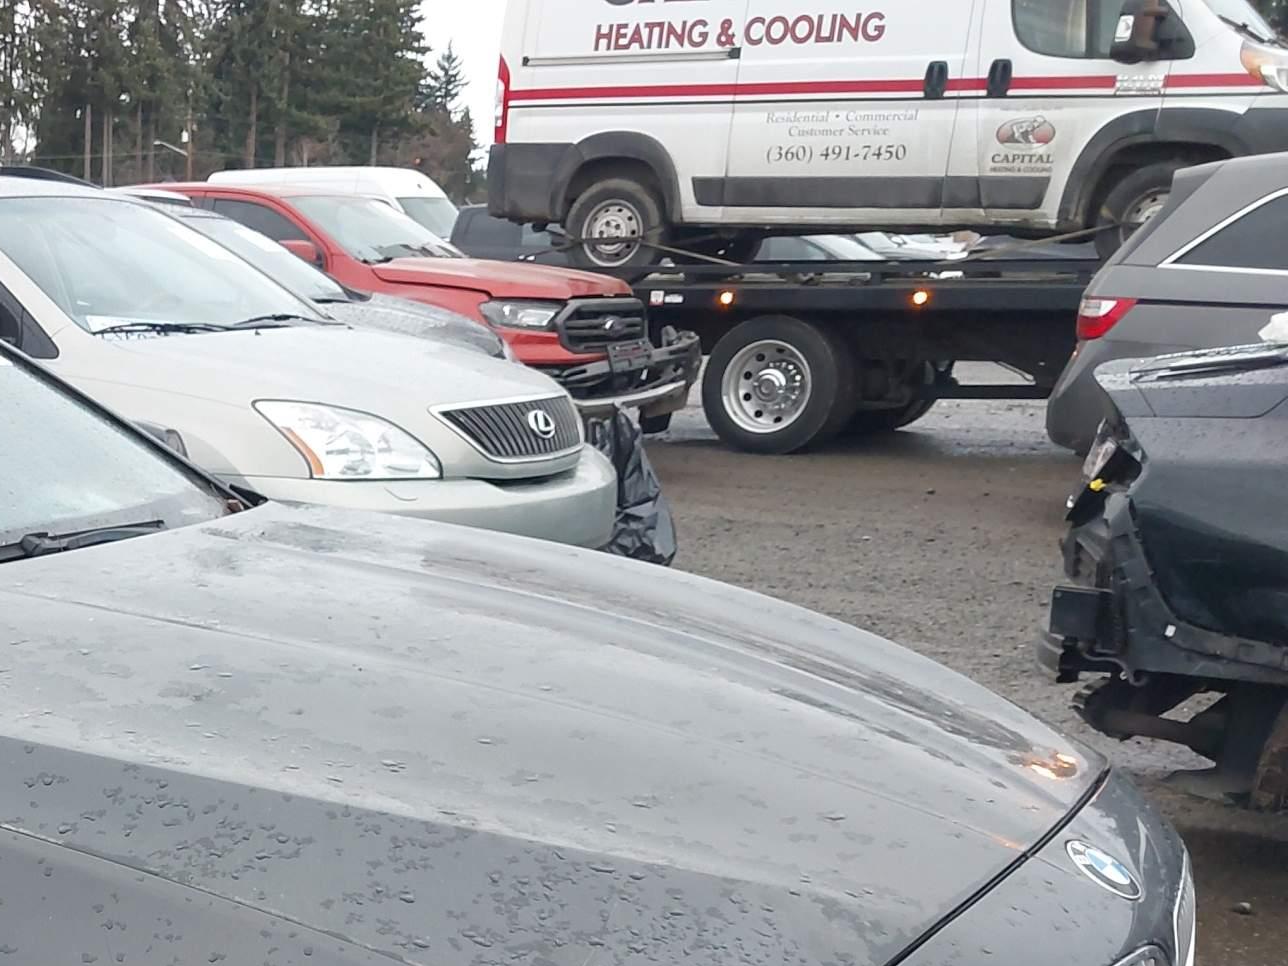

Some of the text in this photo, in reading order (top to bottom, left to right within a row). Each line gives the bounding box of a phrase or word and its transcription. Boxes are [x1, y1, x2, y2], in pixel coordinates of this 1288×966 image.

[594, 12, 886, 51] HEATING & COOLING
[766, 109, 919, 124] Residential Commercial
[788, 125, 890, 138] Customer Service
[766, 143, 908, 163] (360) 491-7450
[991, 153, 1054, 164] CAPITAL
